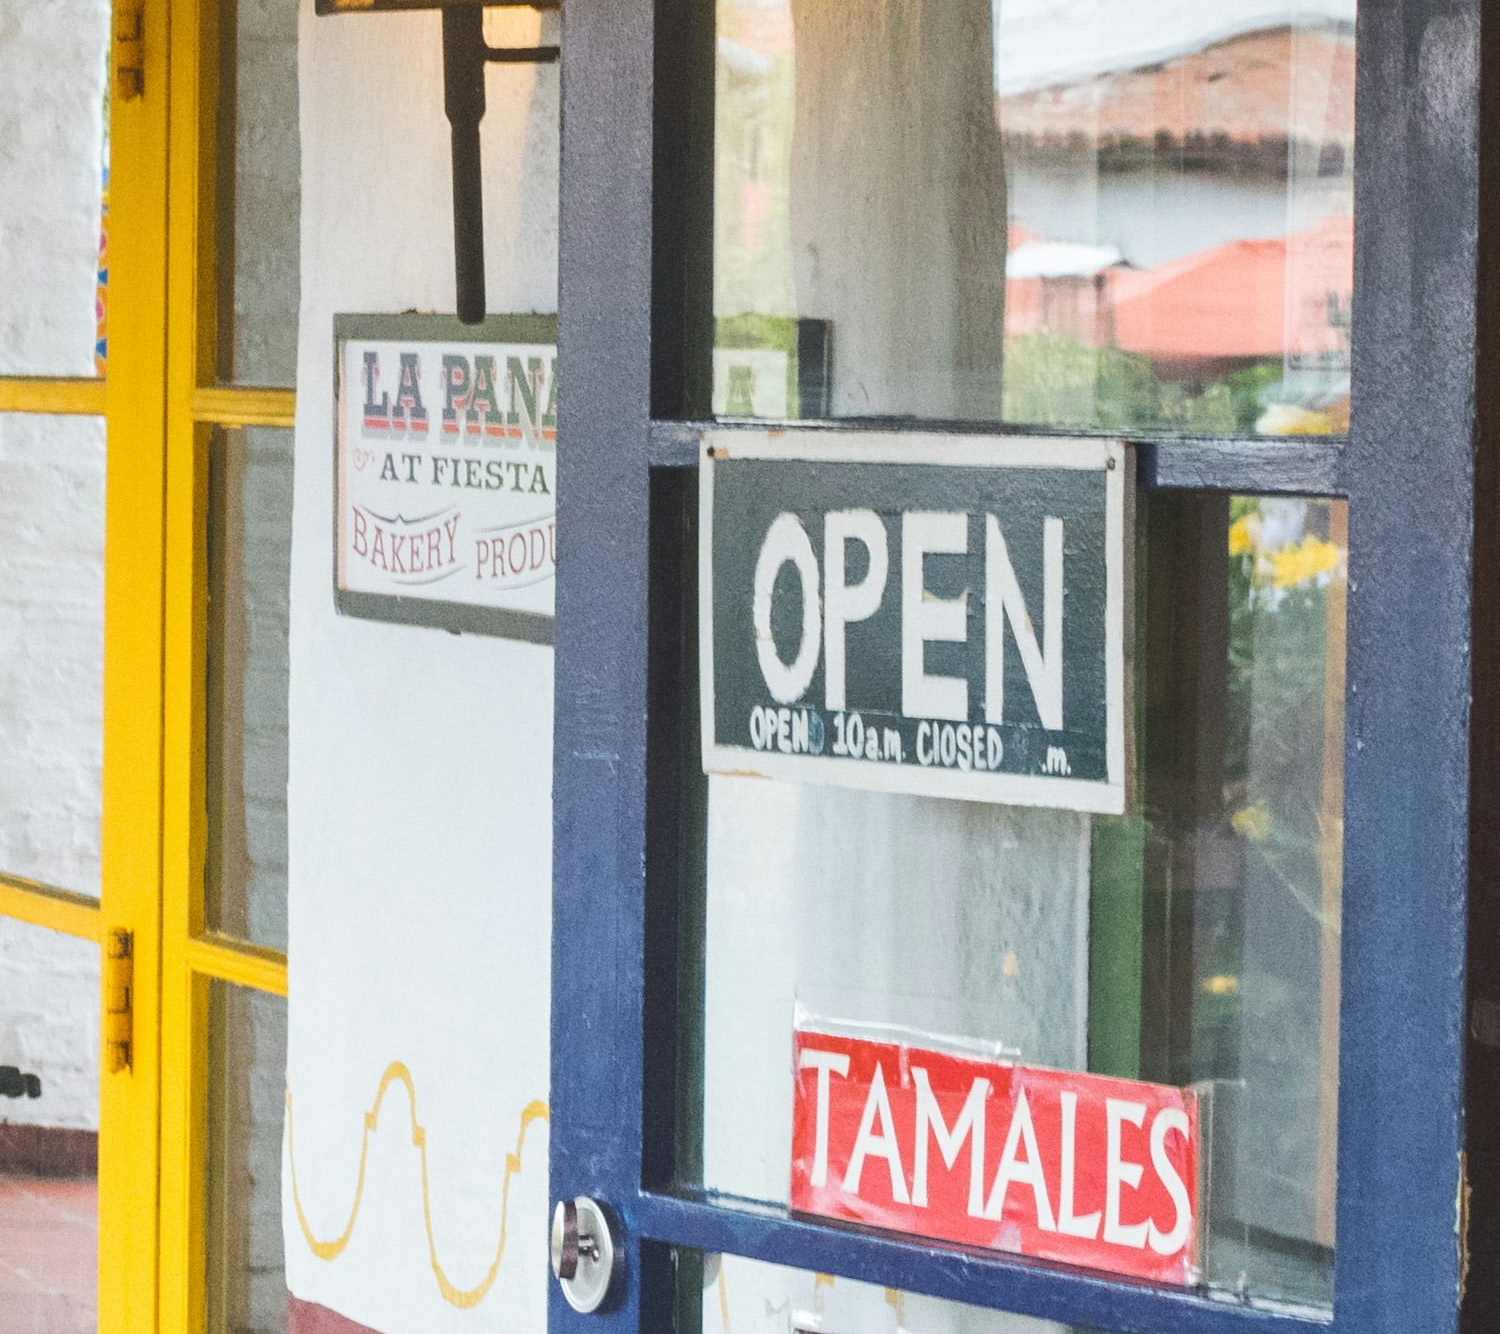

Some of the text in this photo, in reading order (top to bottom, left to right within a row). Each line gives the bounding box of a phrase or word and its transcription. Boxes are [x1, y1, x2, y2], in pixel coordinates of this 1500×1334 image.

[362, 351, 429, 433] LA
[379, 453, 552, 495] AT FIESTA
[351, 505, 461, 574] BAKERY
[754, 508, 1064, 731] OPEN
[800, 1047, 1193, 1256] TAMALES
